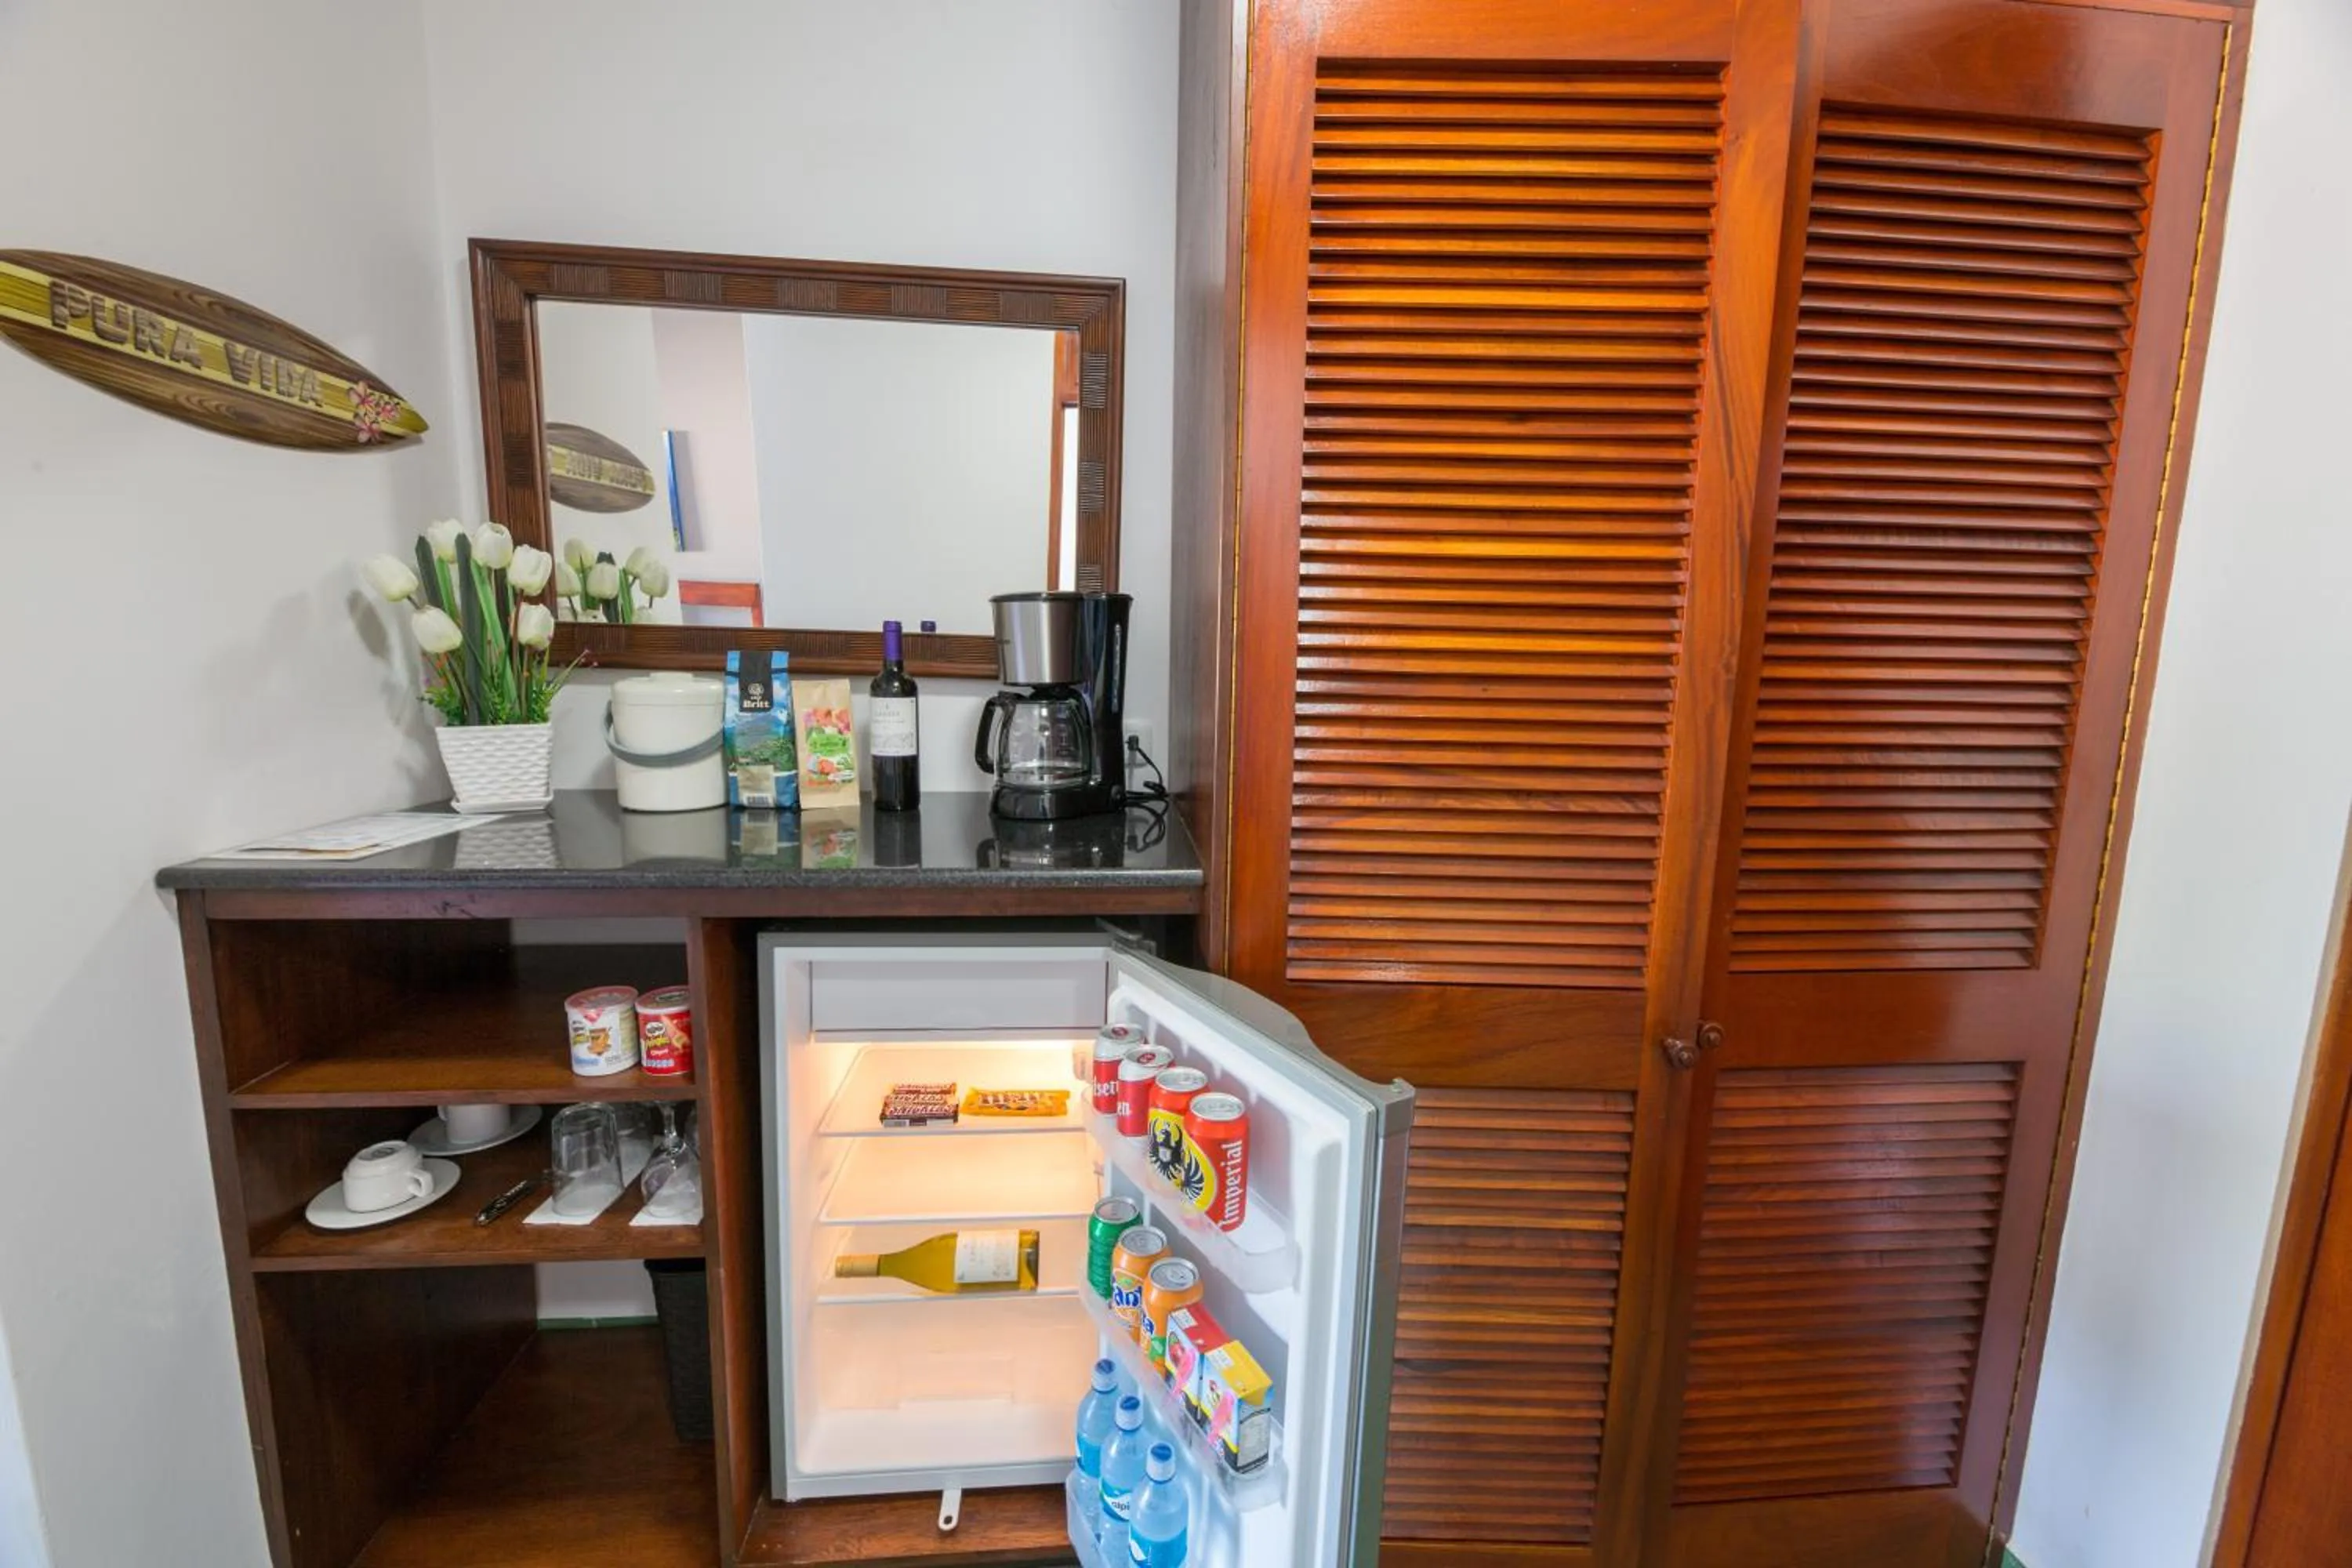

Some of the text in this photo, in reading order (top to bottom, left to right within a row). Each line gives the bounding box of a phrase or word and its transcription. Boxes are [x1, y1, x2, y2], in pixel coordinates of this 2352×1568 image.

[48, 279, 325, 408] PURA VIDA
[1218, 1139, 1243, 1229] Imperial
